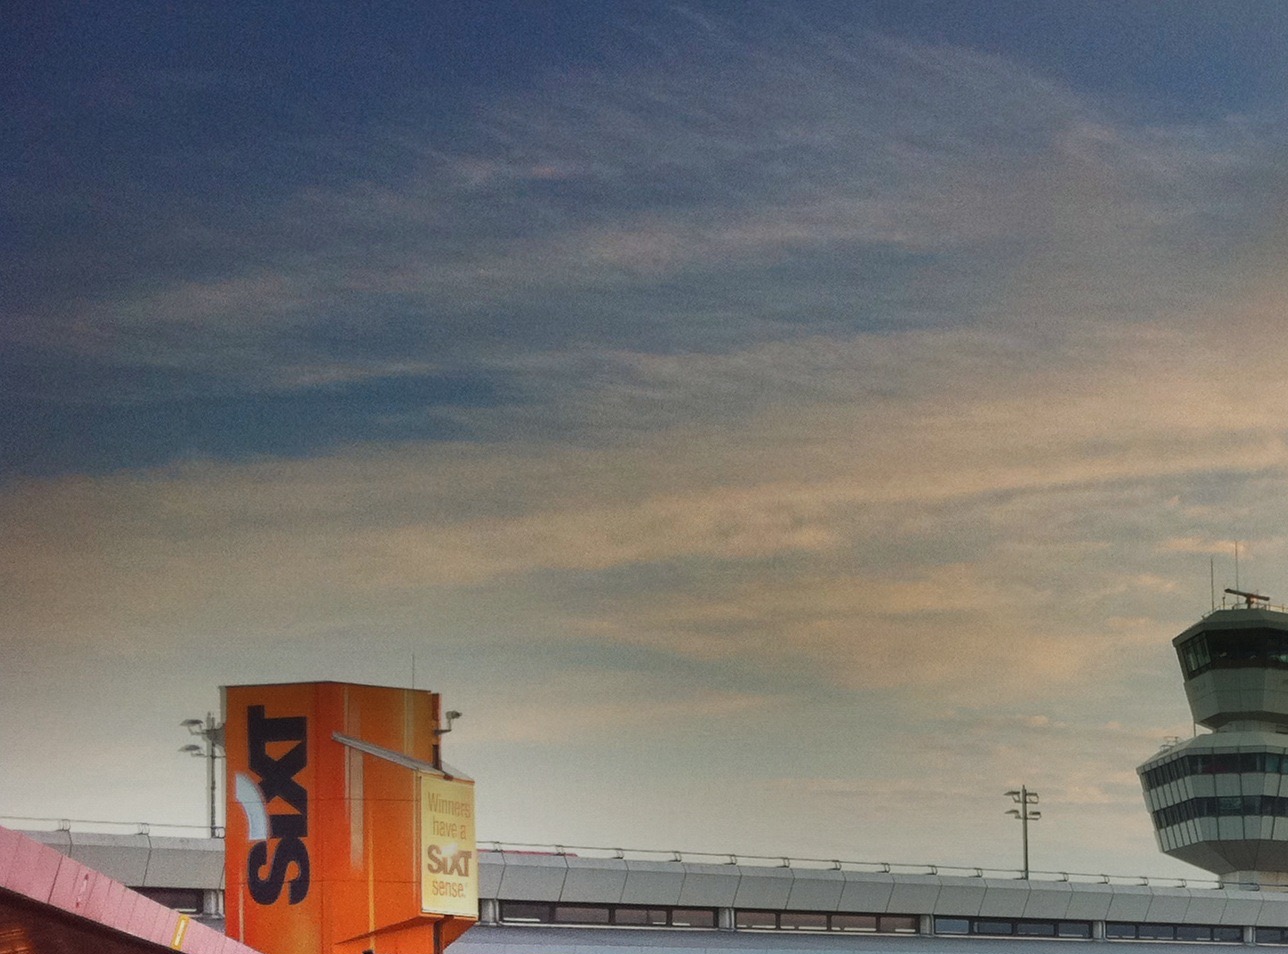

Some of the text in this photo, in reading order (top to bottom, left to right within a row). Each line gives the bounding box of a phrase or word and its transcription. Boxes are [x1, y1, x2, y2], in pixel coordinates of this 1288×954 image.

[427, 791, 471, 818] Winners
[432, 816, 467, 840] have a
